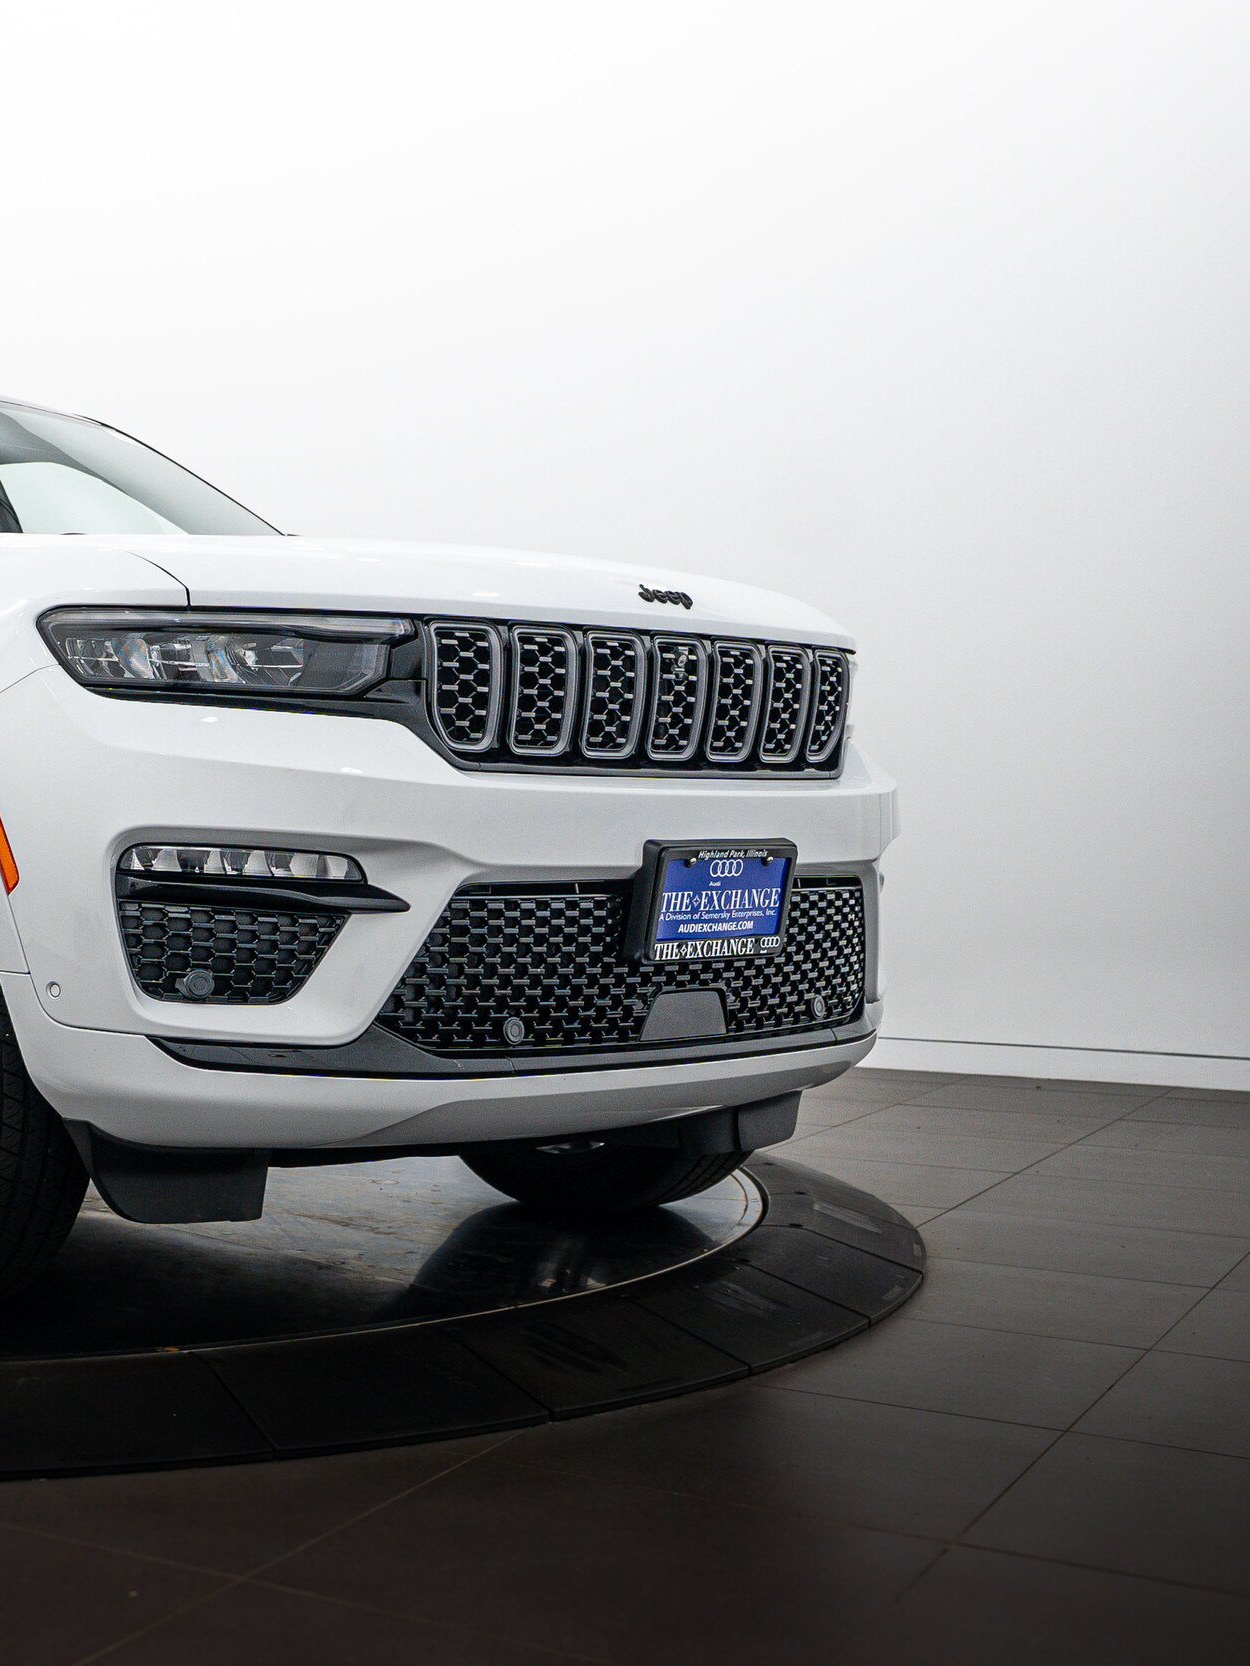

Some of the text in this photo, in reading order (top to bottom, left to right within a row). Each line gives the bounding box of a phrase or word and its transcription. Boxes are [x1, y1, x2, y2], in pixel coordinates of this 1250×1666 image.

[638, 584, 693, 610] Jeep
[698, 850, 768, 860] Highland Park, Illinois
[660, 888, 780, 912] THE EXCHANGE
[659, 913, 665, 921] A
[665, 912, 691, 921] Division
[692, 911, 701, 920] of
[701, 910, 731, 921] Semersky
[678, 920, 754, 933] AUDIEXCHANGE.COM
[654, 938, 755, 960] THE EXCHANGE
